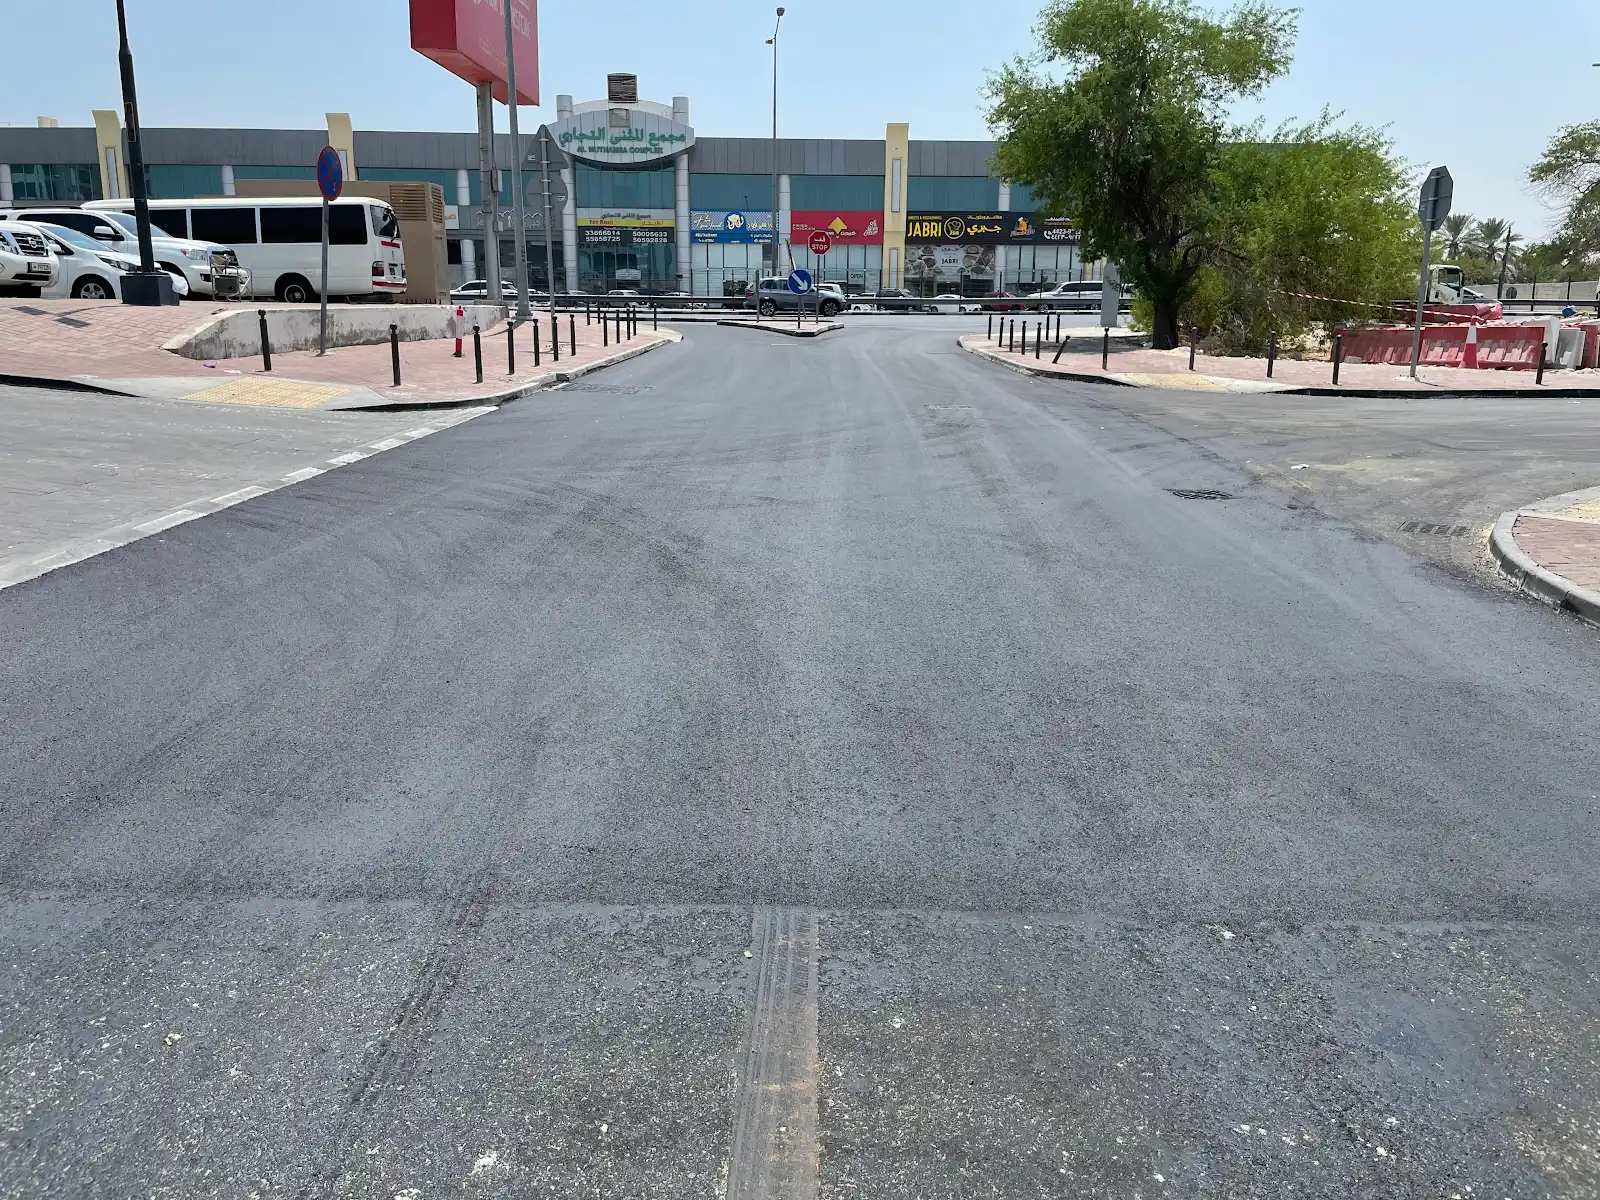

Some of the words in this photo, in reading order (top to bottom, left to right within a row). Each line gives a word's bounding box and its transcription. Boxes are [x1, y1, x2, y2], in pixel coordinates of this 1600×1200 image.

[558, 127, 606, 148] التجاري
[648, 132, 686, 147] مجمع
[907, 222, 942, 237] JABRI
[967, 224, 1003, 236] جبري
[814, 235, 826, 243] قف
[811, 243, 828, 251] STOP
